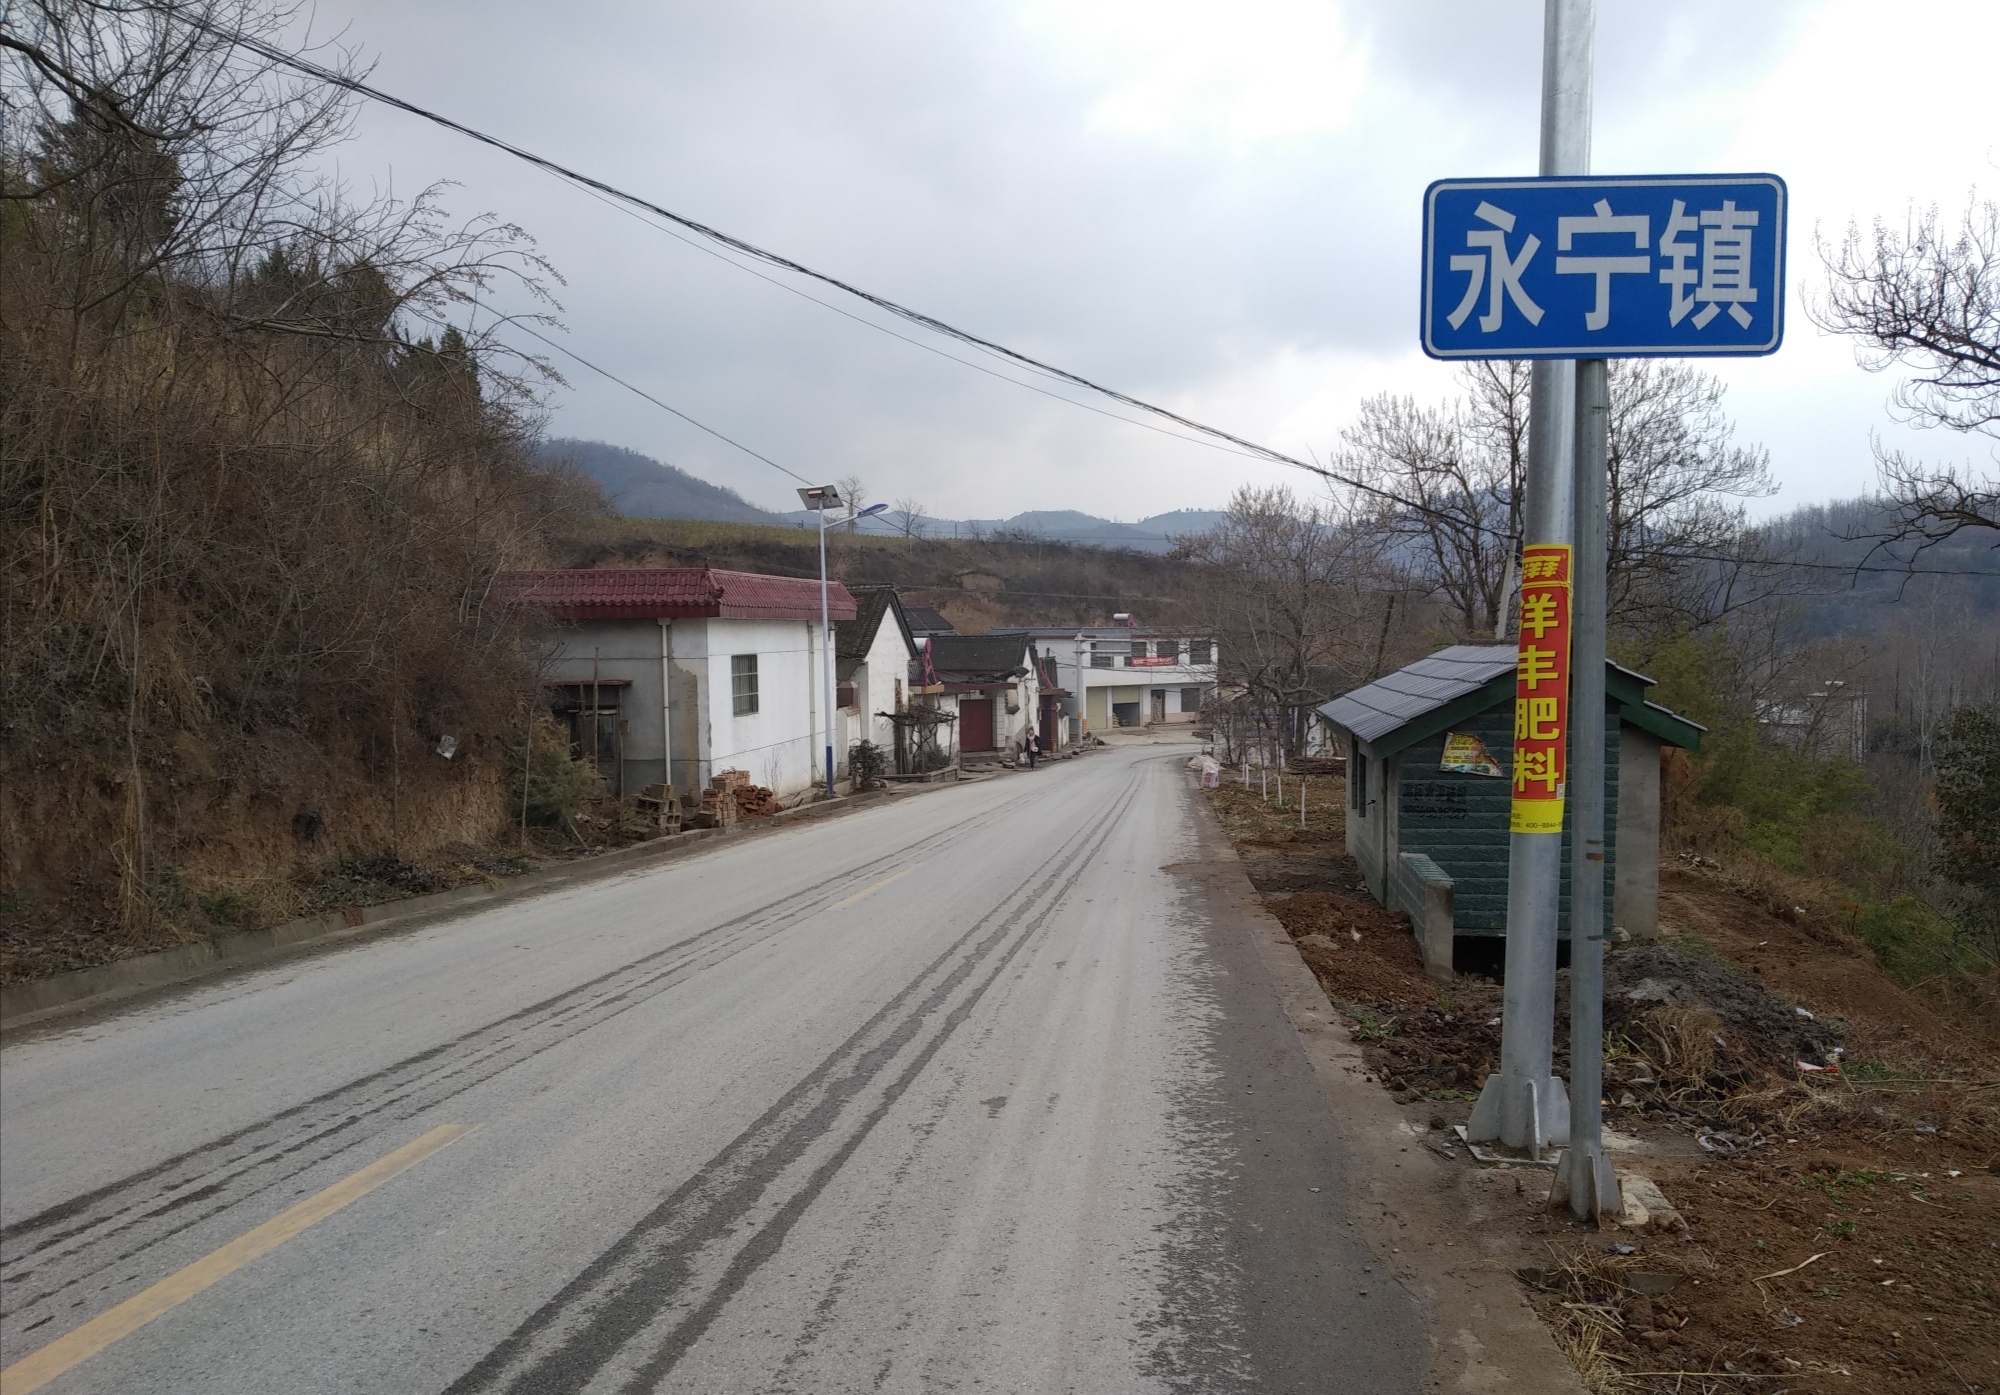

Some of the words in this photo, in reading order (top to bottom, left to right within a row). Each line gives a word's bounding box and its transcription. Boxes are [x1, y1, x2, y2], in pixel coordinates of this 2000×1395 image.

[1446, 198, 1759, 333] 永宁镇
[1513, 593, 1560, 792] 洋丰肥料
